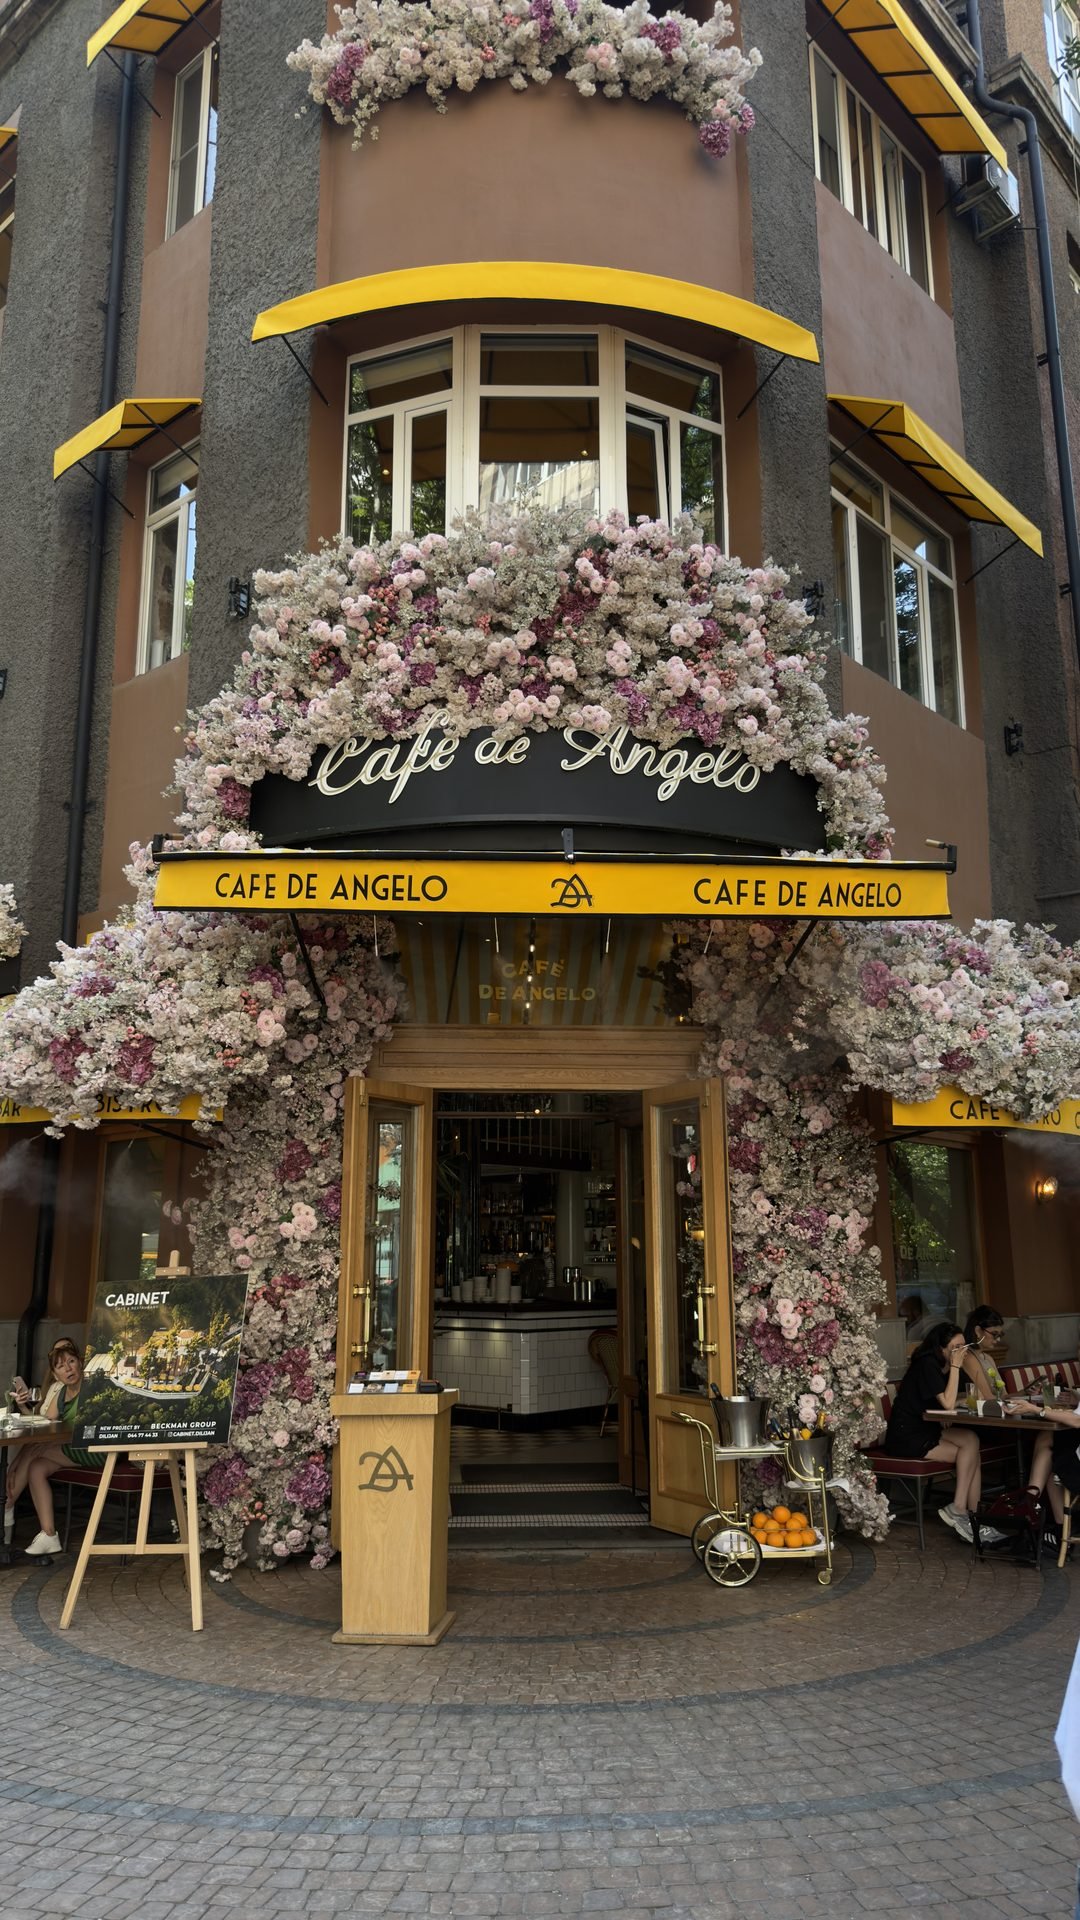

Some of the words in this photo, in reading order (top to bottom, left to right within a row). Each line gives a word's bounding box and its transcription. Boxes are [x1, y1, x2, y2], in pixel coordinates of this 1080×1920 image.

[474, 735, 531, 765] de
[560, 722, 761, 802] Angelo
[215, 872, 276, 899] CAFE
[287, 873, 318, 899] DE
[330, 874, 448, 902] ANGELO
[693, 877, 766, 907] CAFE
[778, 880, 807, 907] DE
[818, 882, 902, 908] ANGELO
[479, 984, 507, 1000] DE
[512, 985, 596, 1001] ANGELO
[0, 1096, 21, 1117] AR
[950, 1100, 1000, 1120] CAFE
[105, 1291, 170, 1307] CABINET
[150, 1422, 188, 1430] BECKMAN
[189, 1421, 217, 1429] GROUP
